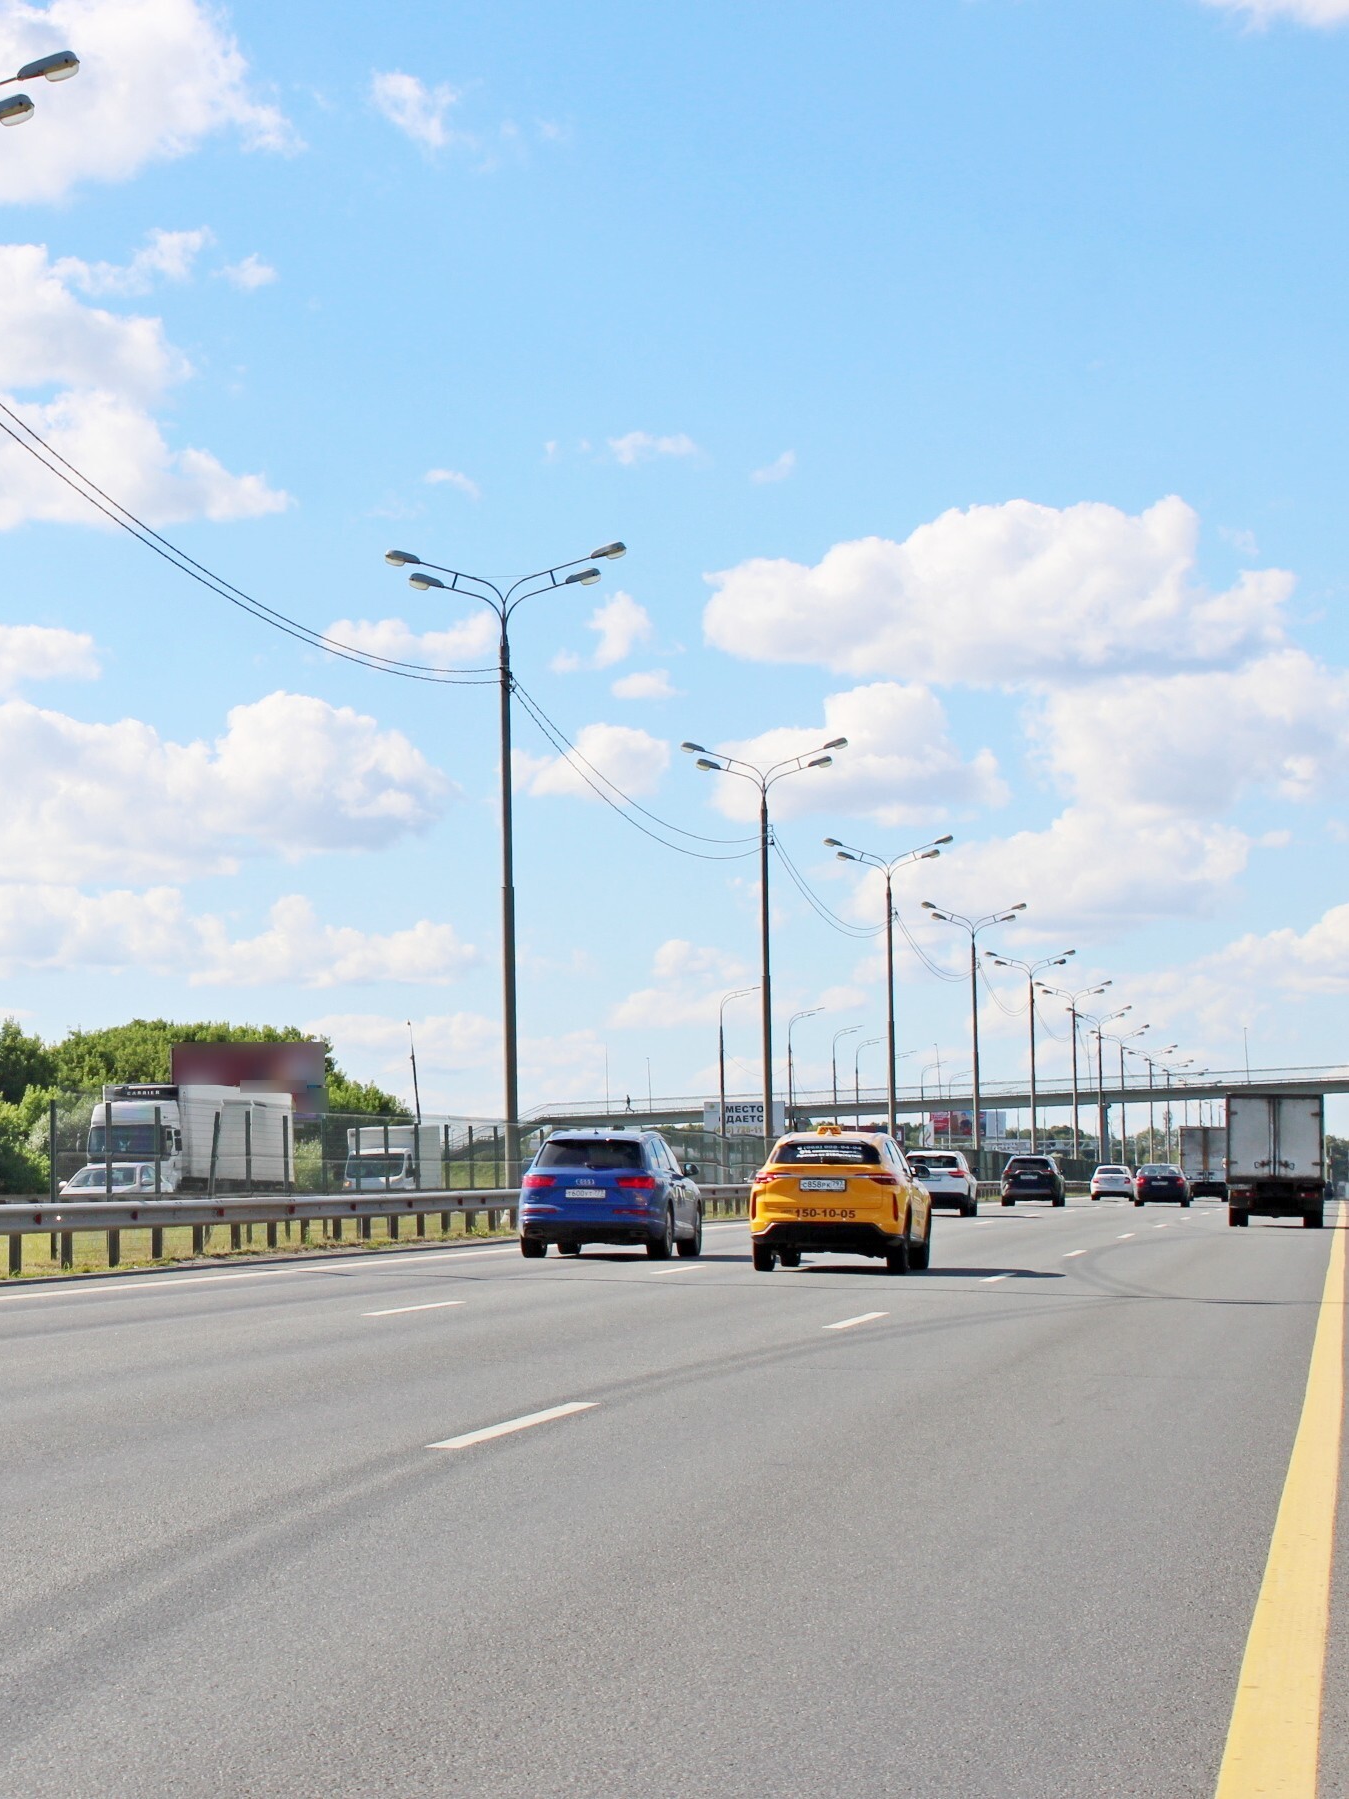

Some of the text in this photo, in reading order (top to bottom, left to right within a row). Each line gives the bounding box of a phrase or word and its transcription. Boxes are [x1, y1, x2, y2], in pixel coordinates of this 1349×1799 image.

[725, 1105, 764, 1113] МЕСТО
[718, 1115, 764, 1124] ДАЕТС
[795, 1209, 856, 1218] 150-10-05
